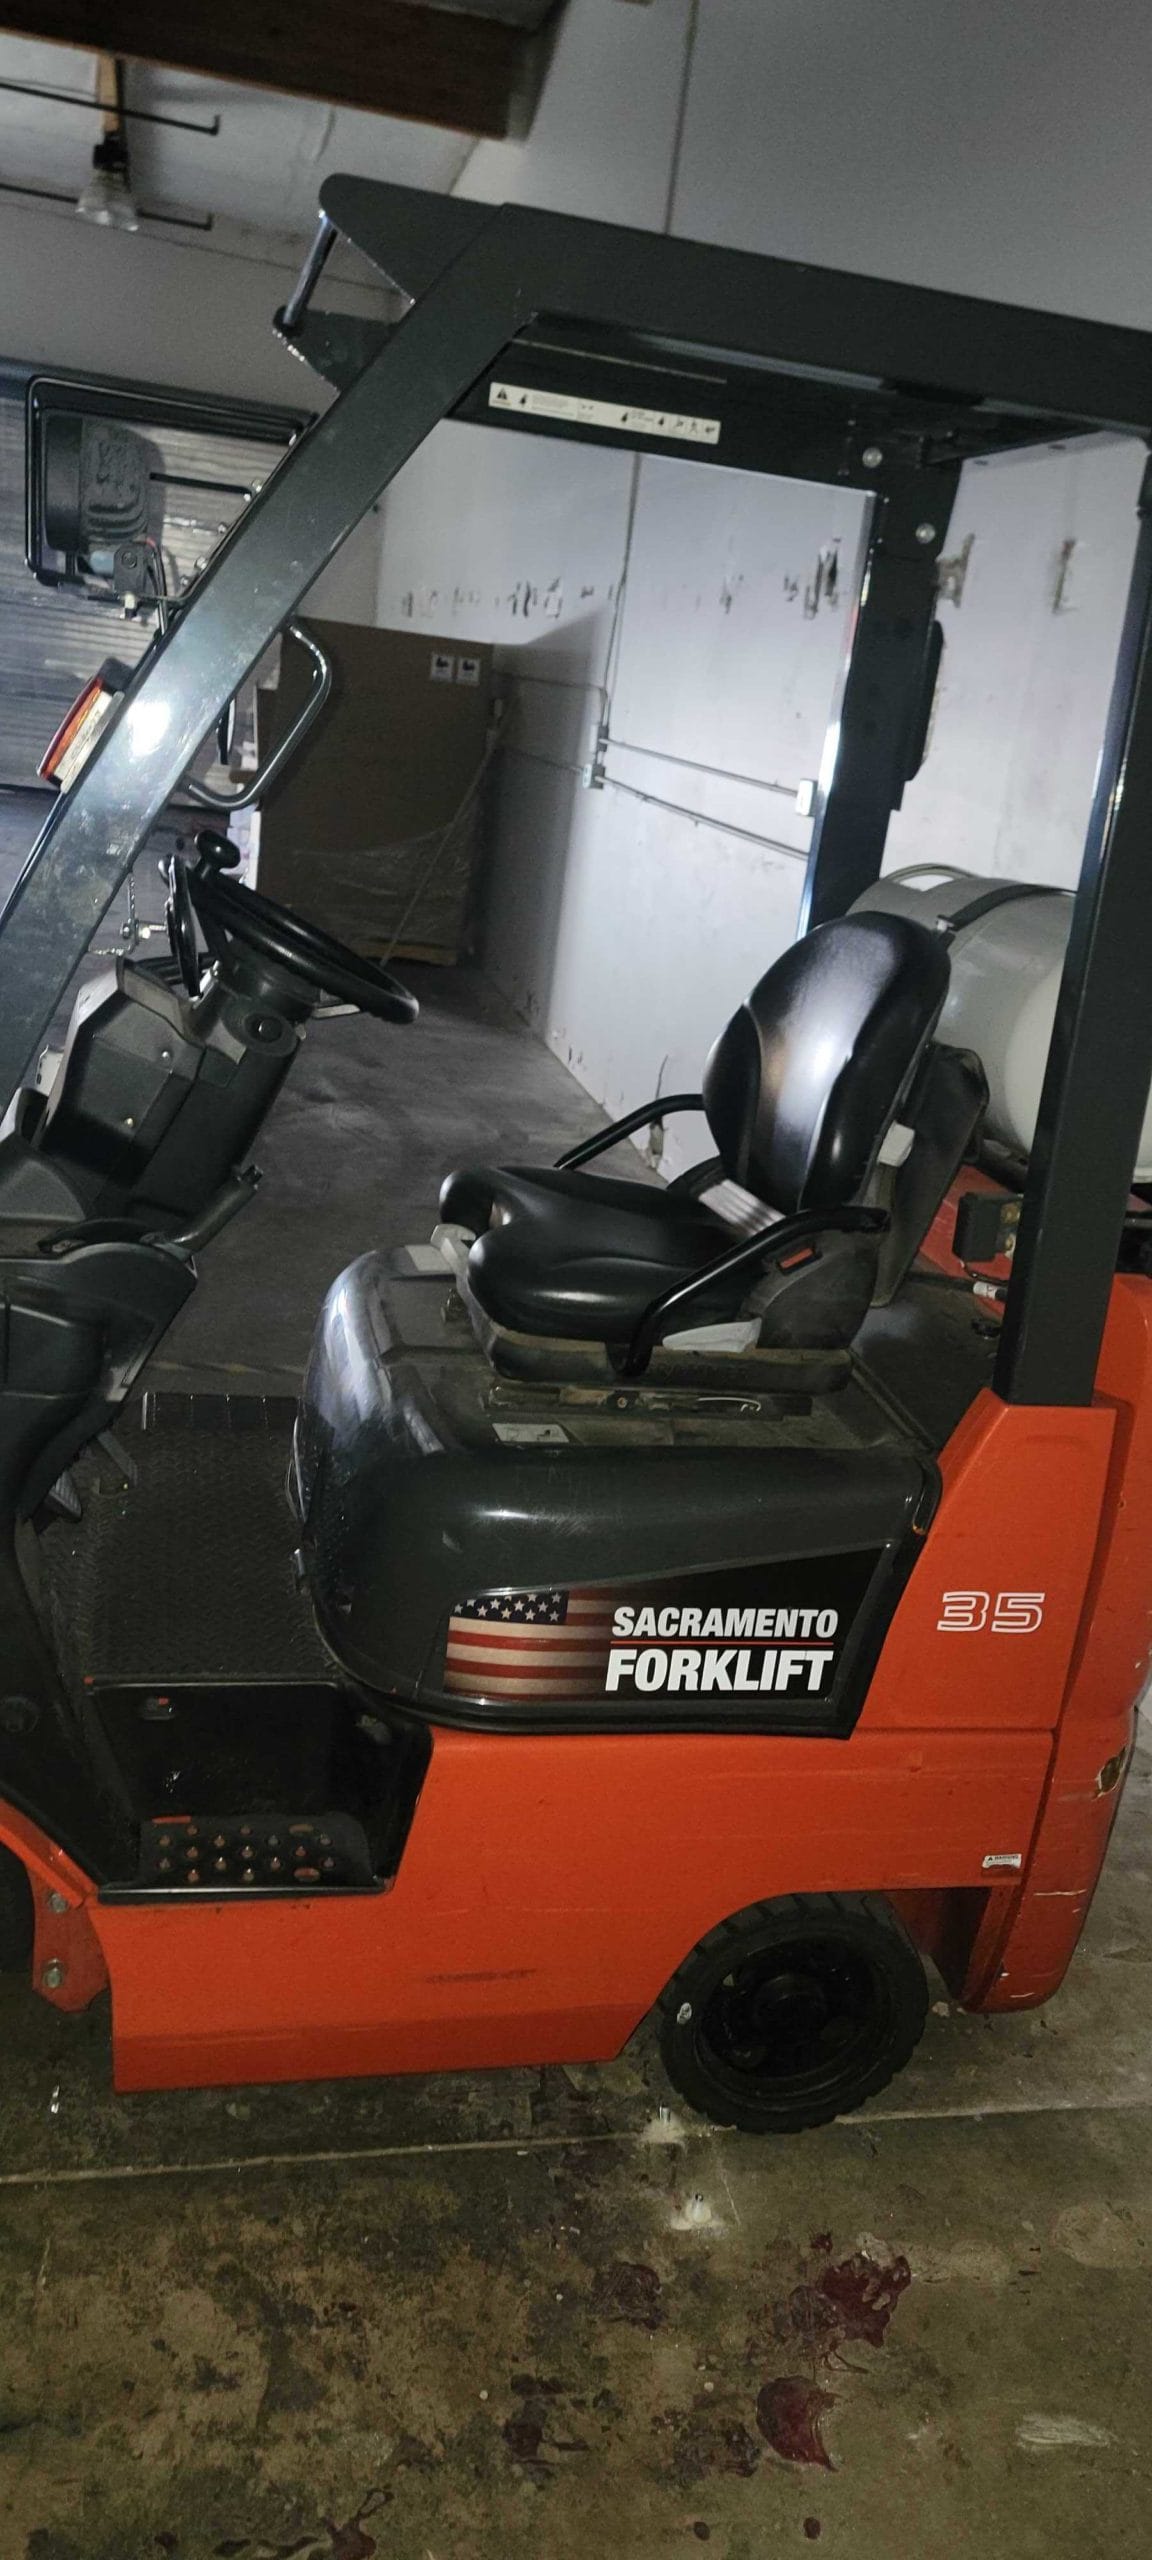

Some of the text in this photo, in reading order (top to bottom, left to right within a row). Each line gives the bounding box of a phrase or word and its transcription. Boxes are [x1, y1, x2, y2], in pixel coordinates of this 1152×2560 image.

[611, 1606, 840, 1638] SACRAMENTO
[936, 1590, 1046, 1634] 35
[605, 1648, 834, 1692] FORKLIFT
